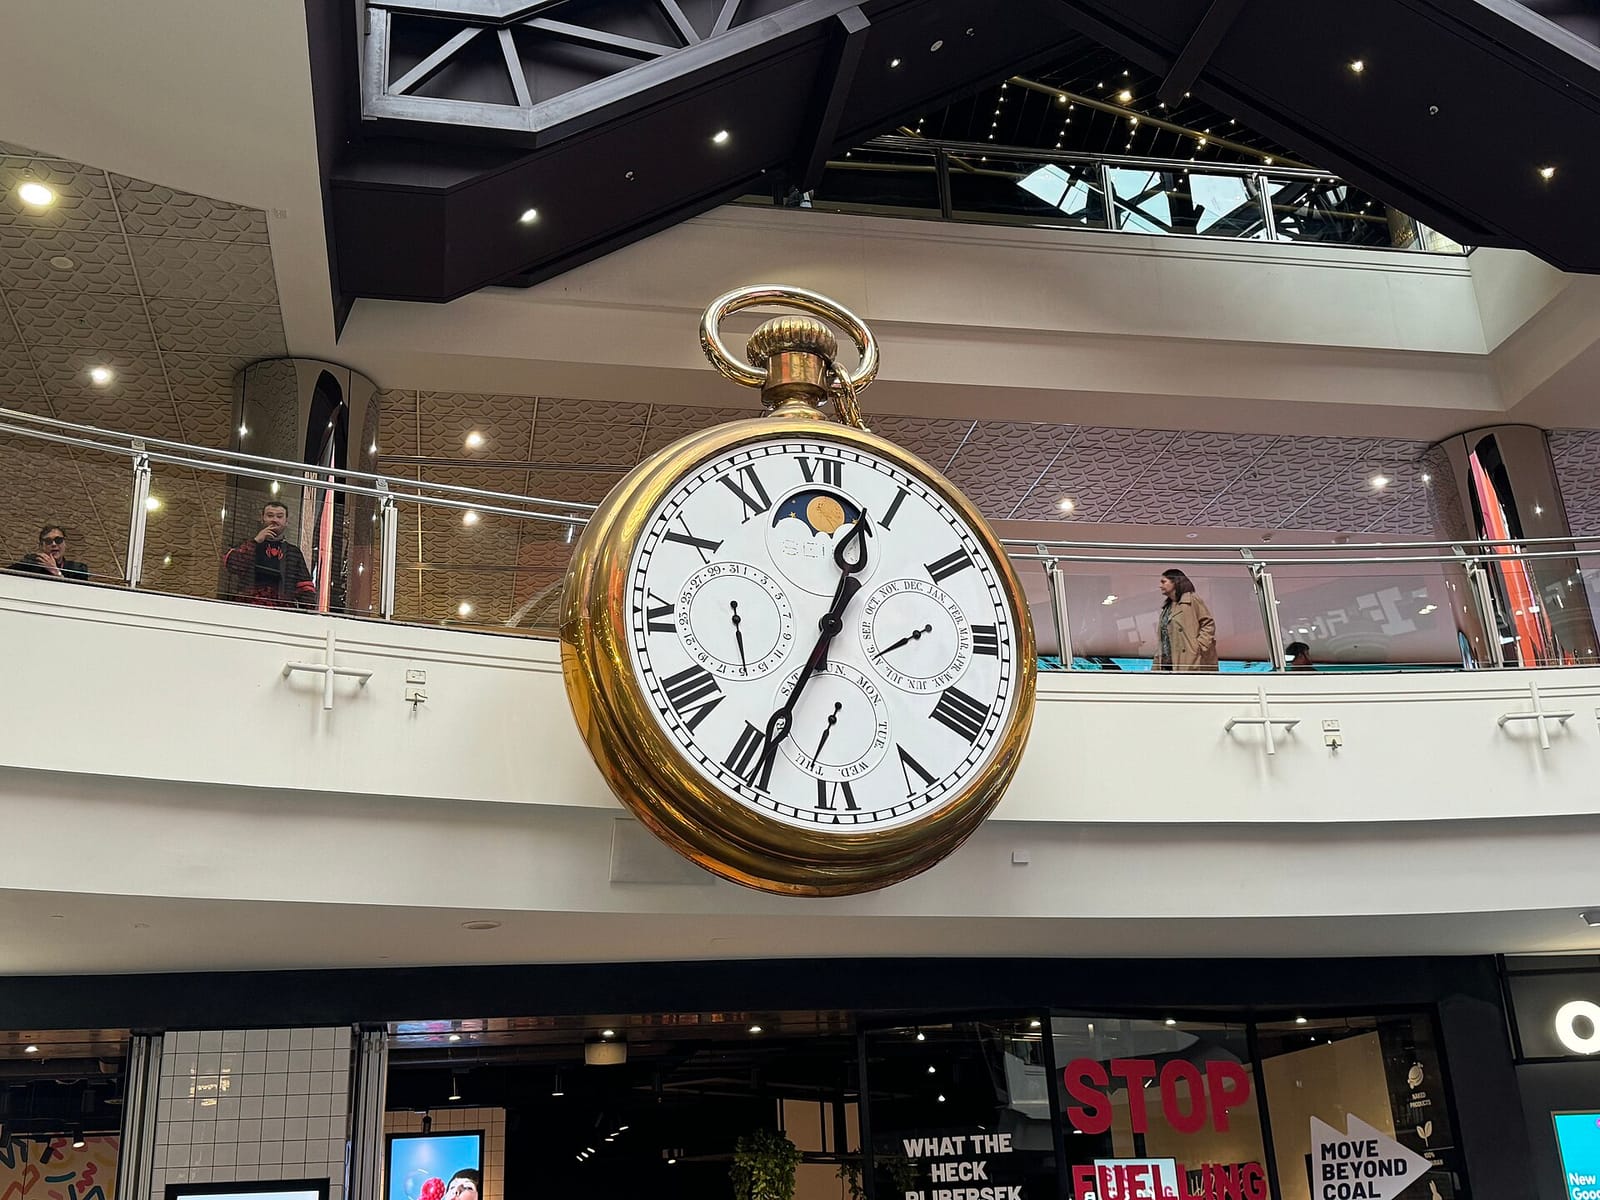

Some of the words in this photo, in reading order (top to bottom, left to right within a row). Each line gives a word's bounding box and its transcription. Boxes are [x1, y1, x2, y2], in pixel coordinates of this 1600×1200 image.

[716, 463, 772, 524] XI
[877, 485, 911, 531] I
[662, 510, 724, 564] X
[707, 565, 722, 577] 29
[924, 544, 975, 585] II
[690, 575, 703, 588] 27
[783, 633, 792, 641] 9
[970, 622, 999, 660] III
[716, 664, 727, 674] 17
[659, 664, 727, 736] VIII
[928, 686, 991, 747] IIII
[896, 742, 940, 798] V
[1064, 1058, 1251, 1134] STOP
[903, 1136, 966, 1158] WHAT
[970, 1133, 1013, 1154] THE
[1321, 1140, 1378, 1160] MOVE
[931, 1161, 988, 1183] HECK
[1072, 1161, 1267, 1200] FUELLING
[1322, 1159, 1407, 1181] BEYOND
[1569, 1172, 1596, 1185] New
[1323, 1181, 1381, 1200] COAL
